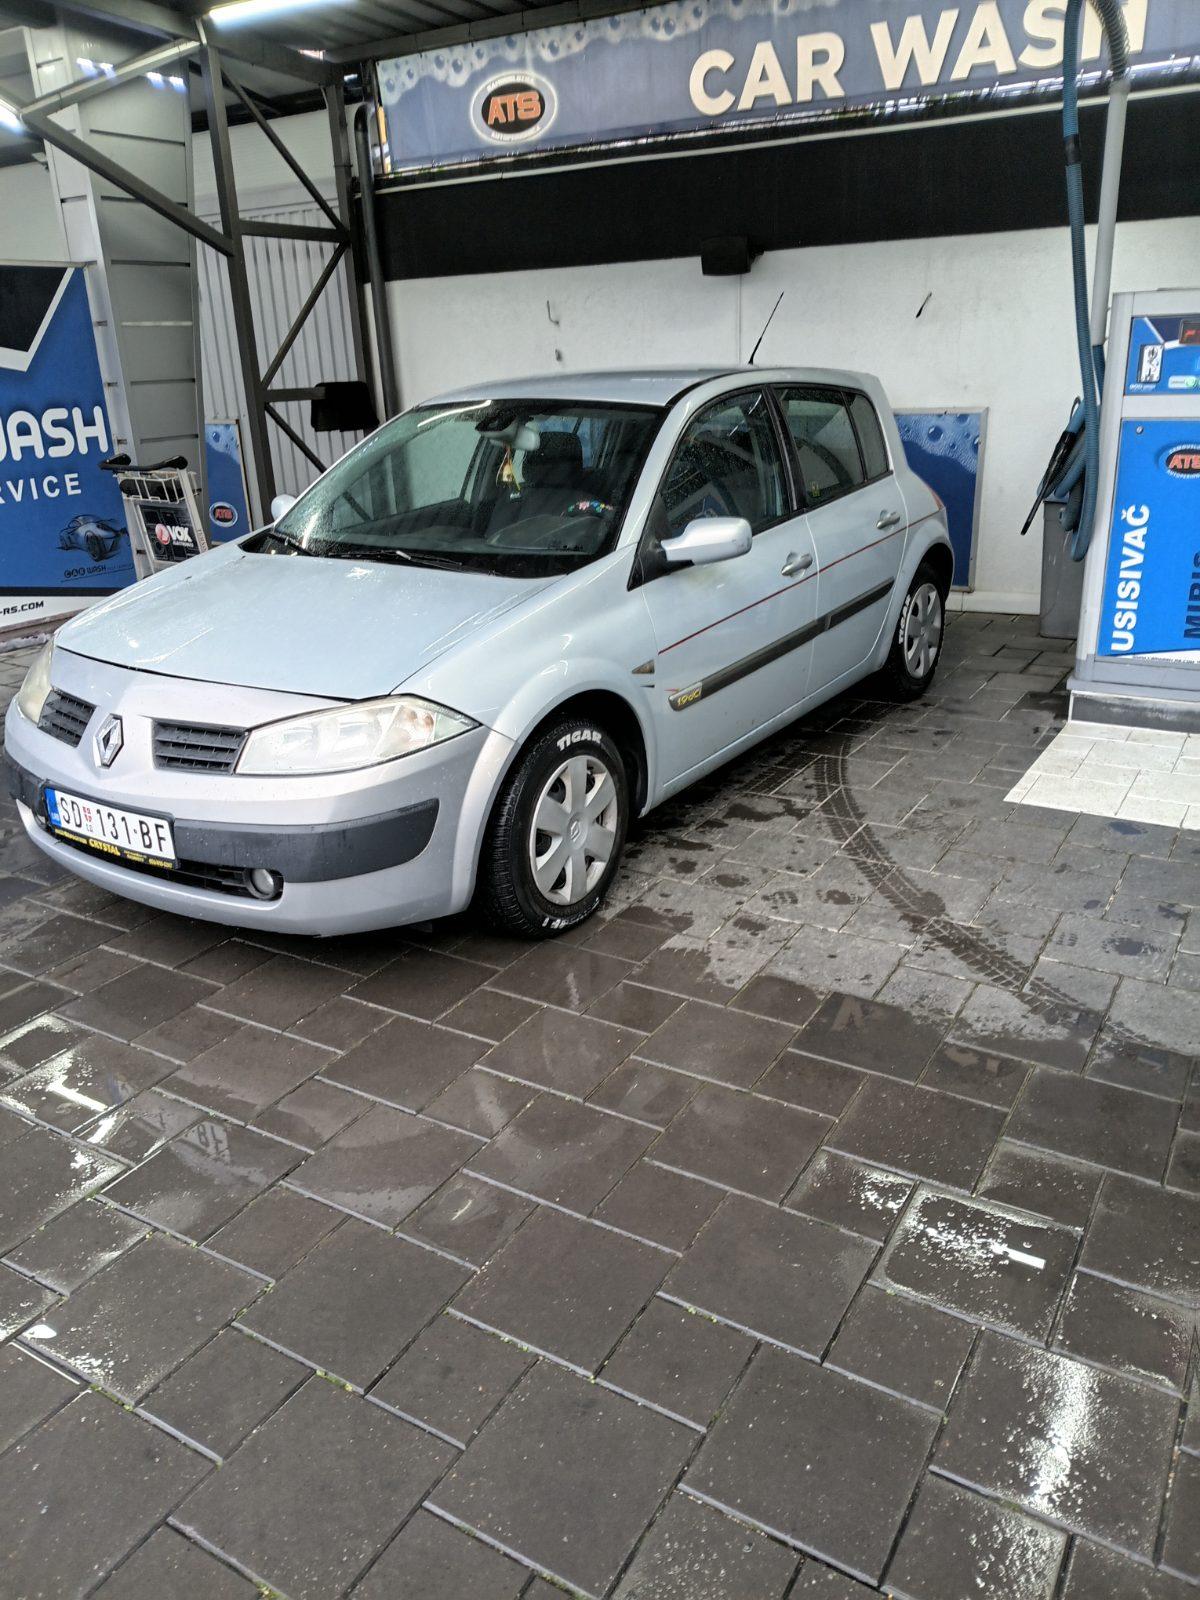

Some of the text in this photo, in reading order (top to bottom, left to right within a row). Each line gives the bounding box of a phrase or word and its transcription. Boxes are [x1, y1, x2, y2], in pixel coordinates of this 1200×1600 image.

[689, 0, 1148, 116] CAR WASH
[487, 90, 541, 125] ATS
[0, 473, 82, 504] VICE
[166, 525, 193, 542] VOX
[1111, 504, 1150, 652] USISIVAČ
[557, 729, 602, 751] TIGAR
[60, 796, 82, 828] SD
[89, 838, 121, 856] CRYSTAL
